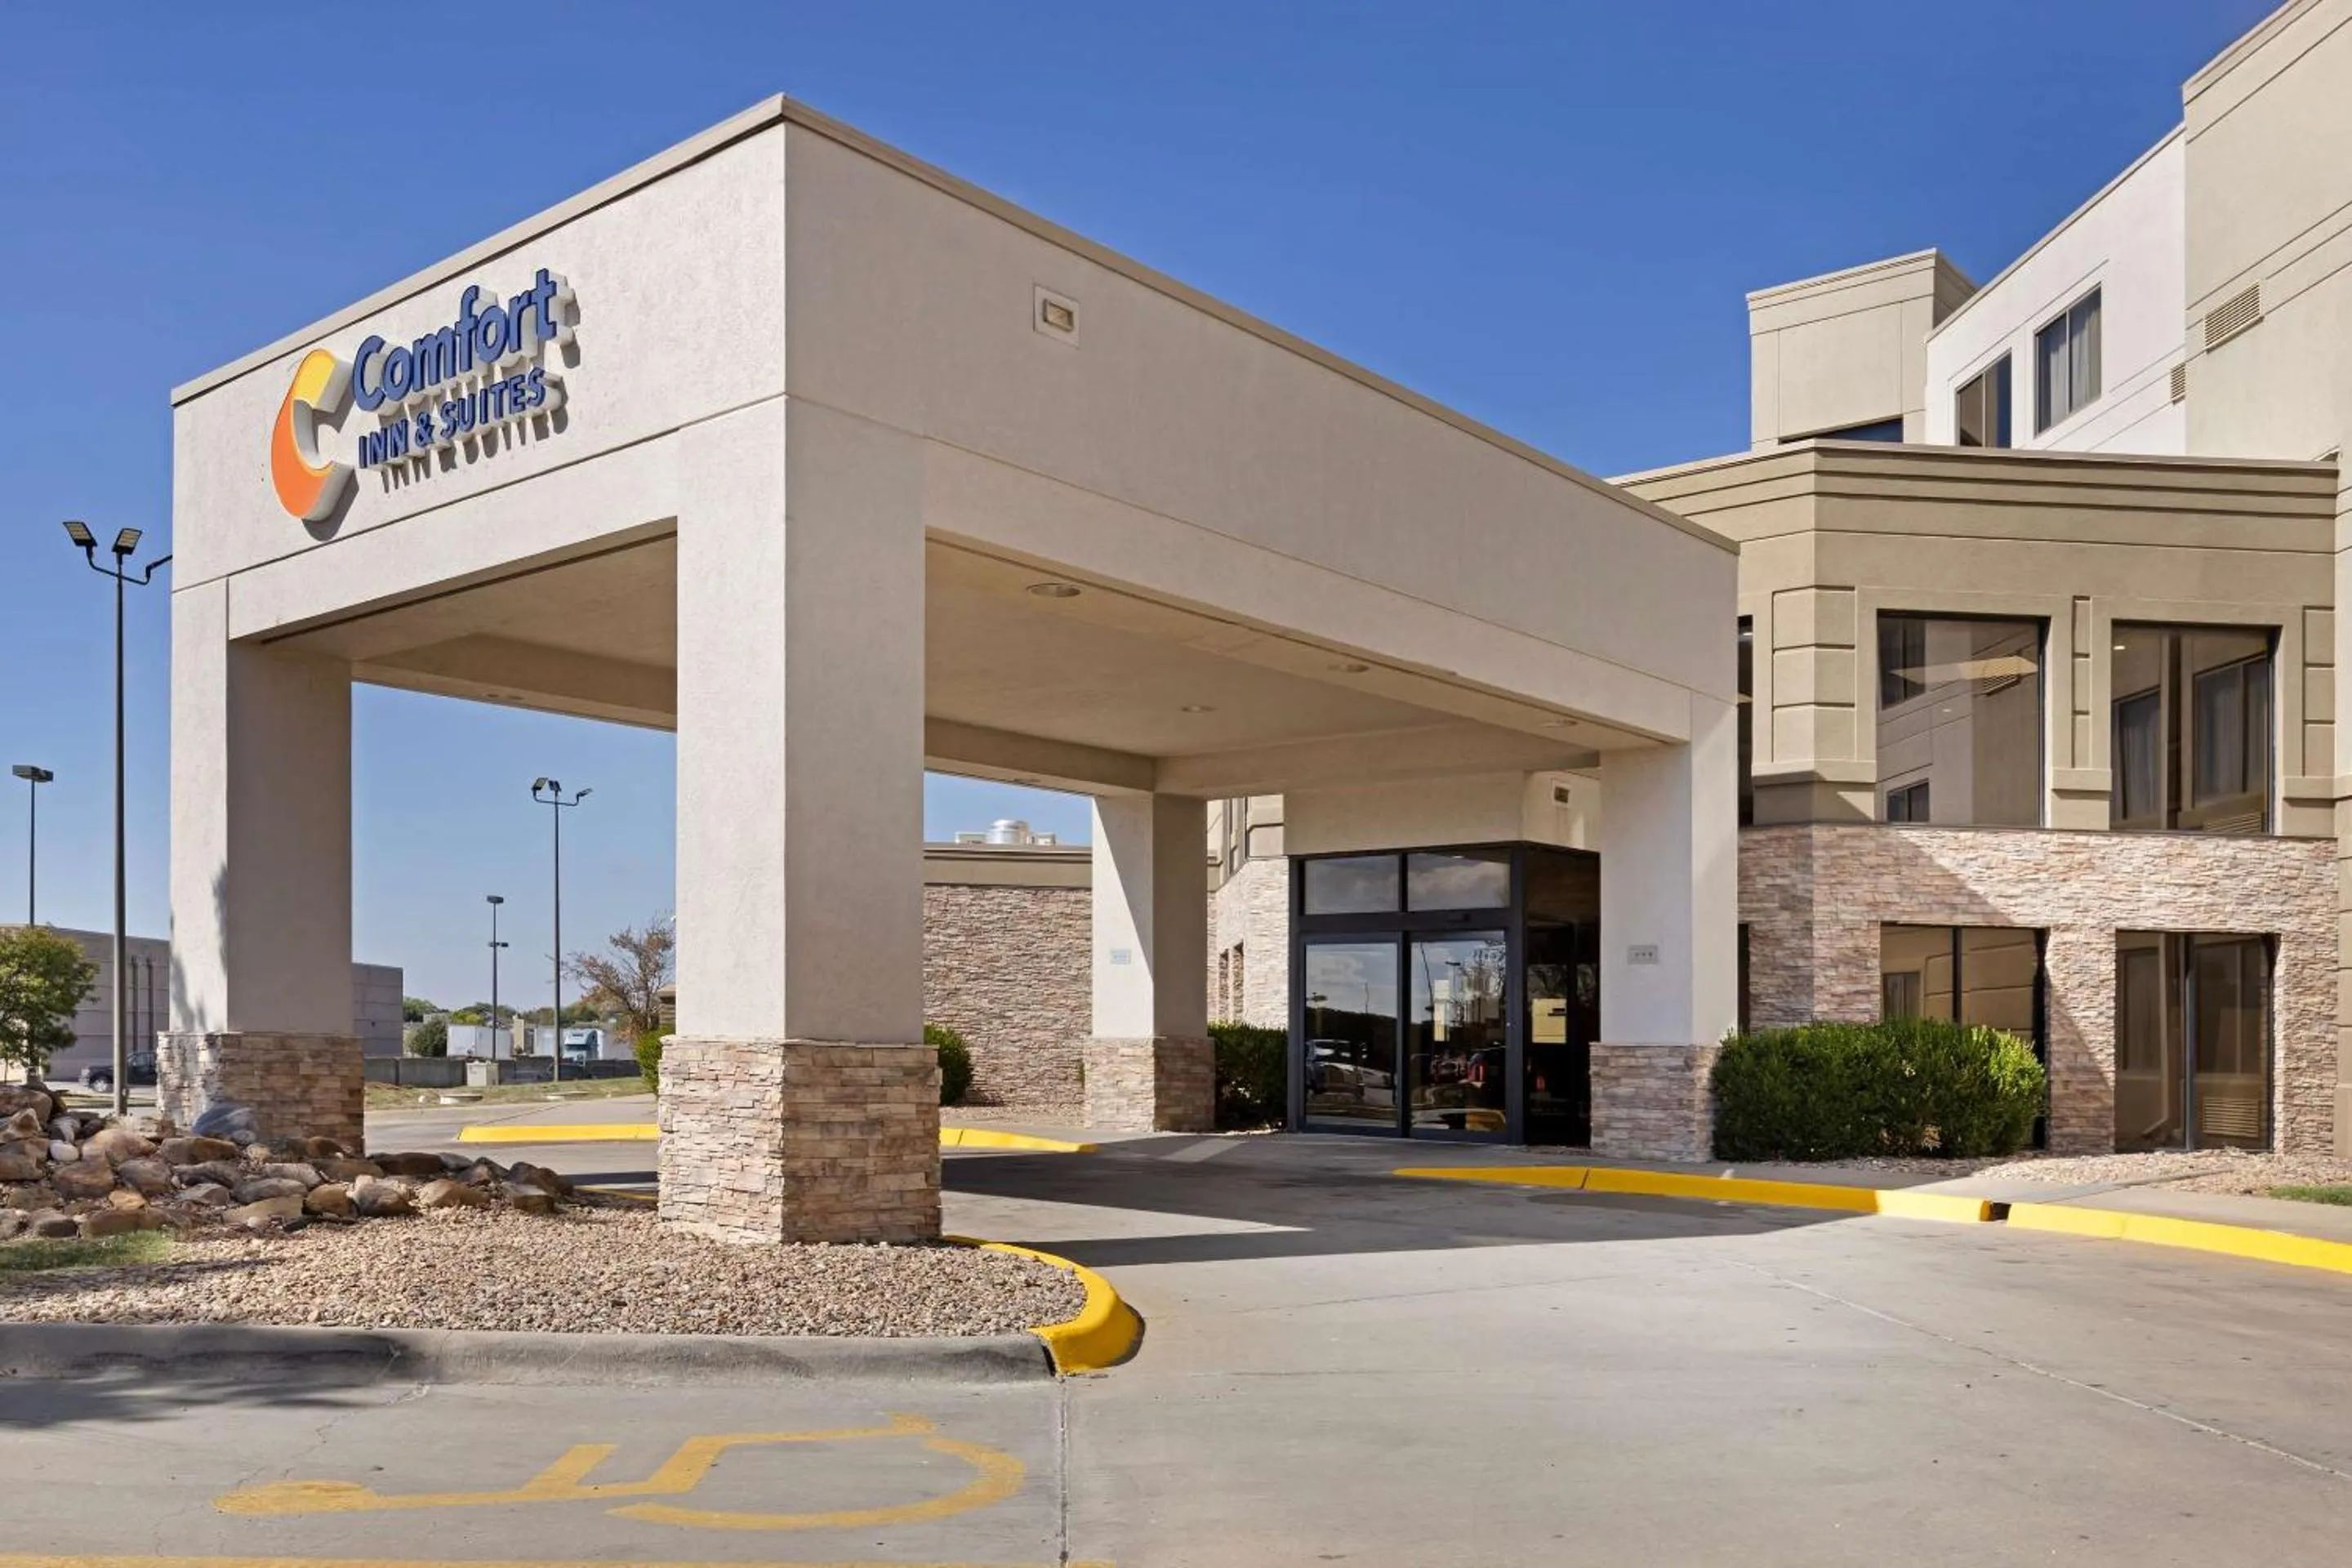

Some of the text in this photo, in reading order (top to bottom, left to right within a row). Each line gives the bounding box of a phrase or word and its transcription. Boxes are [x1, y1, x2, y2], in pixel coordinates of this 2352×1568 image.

[353, 268, 557, 411] Comfort
[359, 367, 546, 469] INN & SUITES
